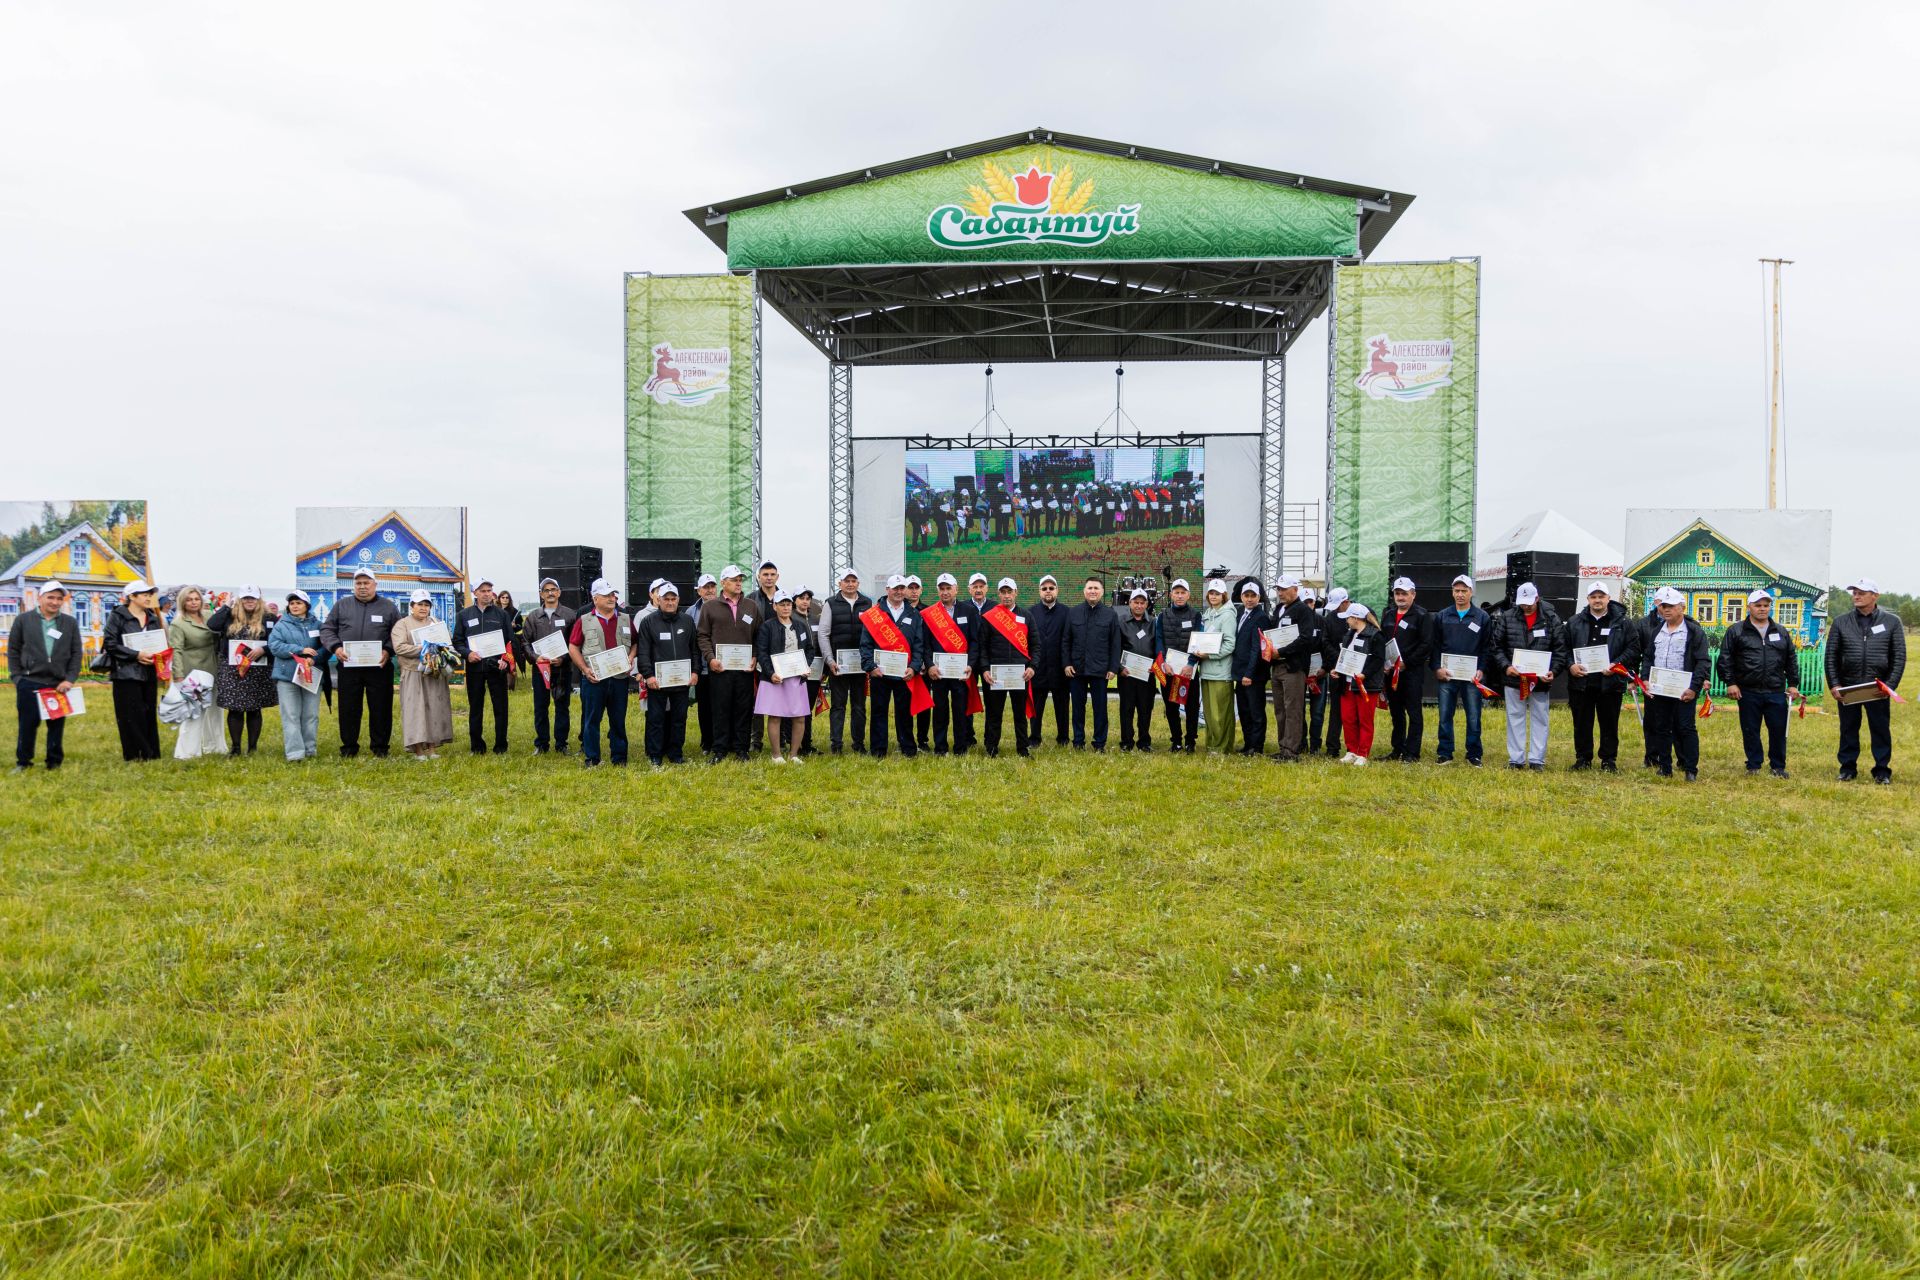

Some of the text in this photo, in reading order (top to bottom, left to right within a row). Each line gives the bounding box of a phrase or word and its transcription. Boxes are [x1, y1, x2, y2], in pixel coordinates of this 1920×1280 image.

[929, 204, 1140, 248] Сабантуй
[674, 350, 728, 364] АЛЕКСЕЕВСКИЙ
[1392, 342, 1450, 357] АЛЕКСЕЕВСКИЙ
[683, 367, 707, 380] район
[1401, 360, 1427, 374] район
[995, 610, 1018, 631] БАТЫР
[880, 624, 899, 645] СЕВА
[945, 628, 964, 650] СЕВА
